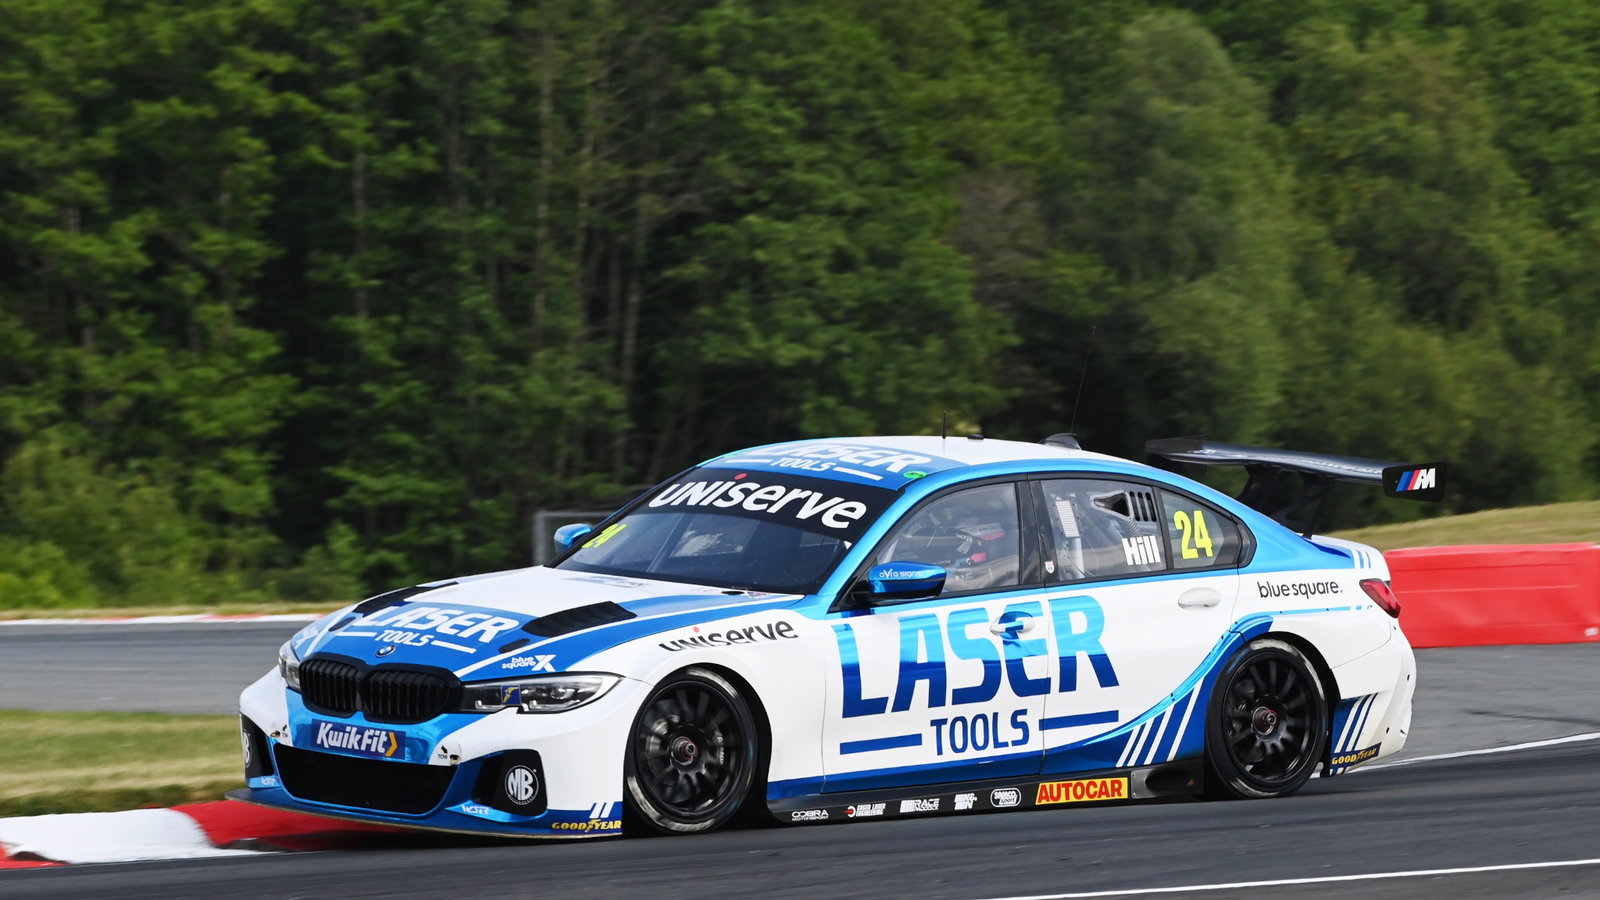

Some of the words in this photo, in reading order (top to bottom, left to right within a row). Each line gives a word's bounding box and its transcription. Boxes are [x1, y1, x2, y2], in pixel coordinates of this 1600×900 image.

[744, 443, 931, 474] LASER
[770, 457, 836, 472] TOOLS
[1173, 510, 1214, 560] 24
[1121, 535, 1161, 566] Hill
[1256, 580, 1291, 599] blue
[351, 605, 519, 643] LASER
[374, 629, 434, 647] TOOLS
[501, 661, 537, 669] square
[511, 656, 534, 664] blue
[830, 594, 1121, 719] LASER
[930, 708, 1030, 757] TOOLS
[507, 768, 534, 801] MB
[1037, 779, 1123, 804] AUTOCAR
[791, 809, 829, 818] COBRA
[914, 798, 941, 808] RACE
[551, 818, 622, 832] GOODYEAR
